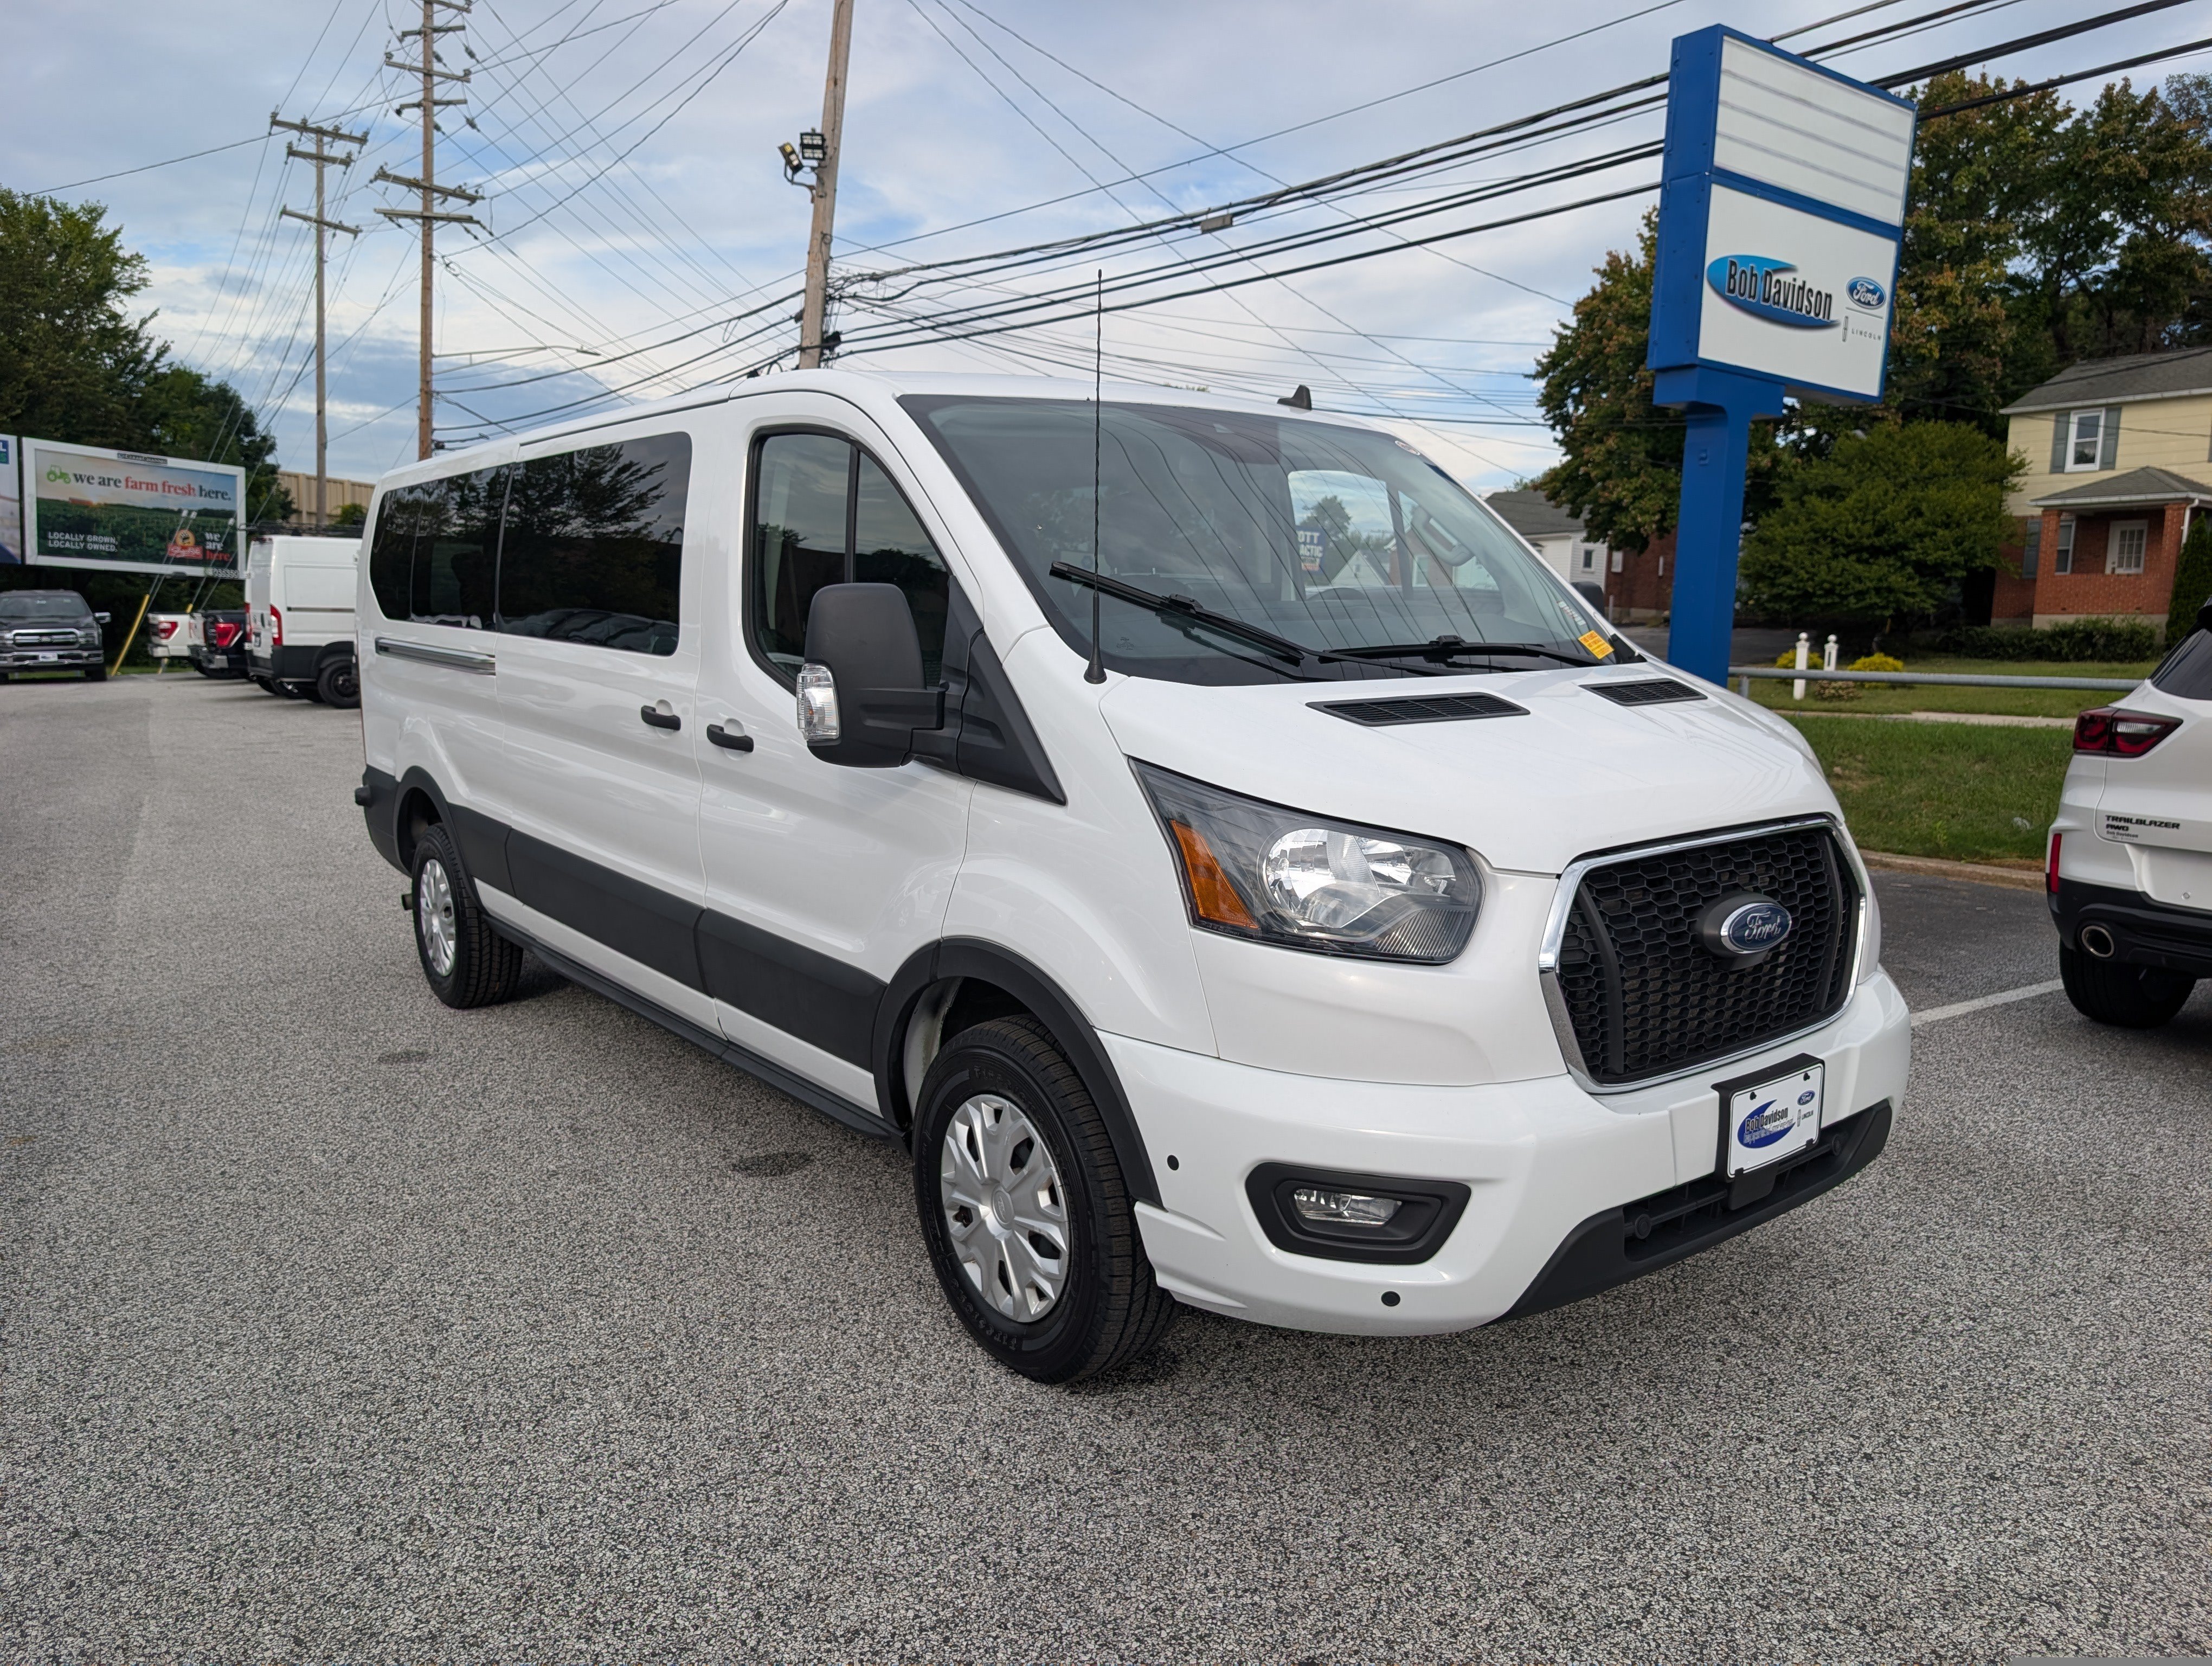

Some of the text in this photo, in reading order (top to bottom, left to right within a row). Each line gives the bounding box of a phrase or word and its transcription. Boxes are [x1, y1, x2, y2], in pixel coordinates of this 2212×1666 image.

[1726, 259, 1832, 321] Bob Davidson
[1853, 281, 1879, 306] Ford
[1851, 328, 1881, 341] LINCOLN
[73, 472, 231, 501] we are farm fresh here.
[48, 531, 85, 541] LOCALLY
[48, 540, 85, 549] LOCALLY
[2105, 815, 2181, 830] TRAILBLAZER
[2106, 823, 2130, 831] AWD
[1745, 911, 1782, 941] Ford
[1799, 1092, 1813, 1104] Ford
[1745, 1116, 1759, 1132] Bob
[1760, 1107, 1789, 1127] Davidson
